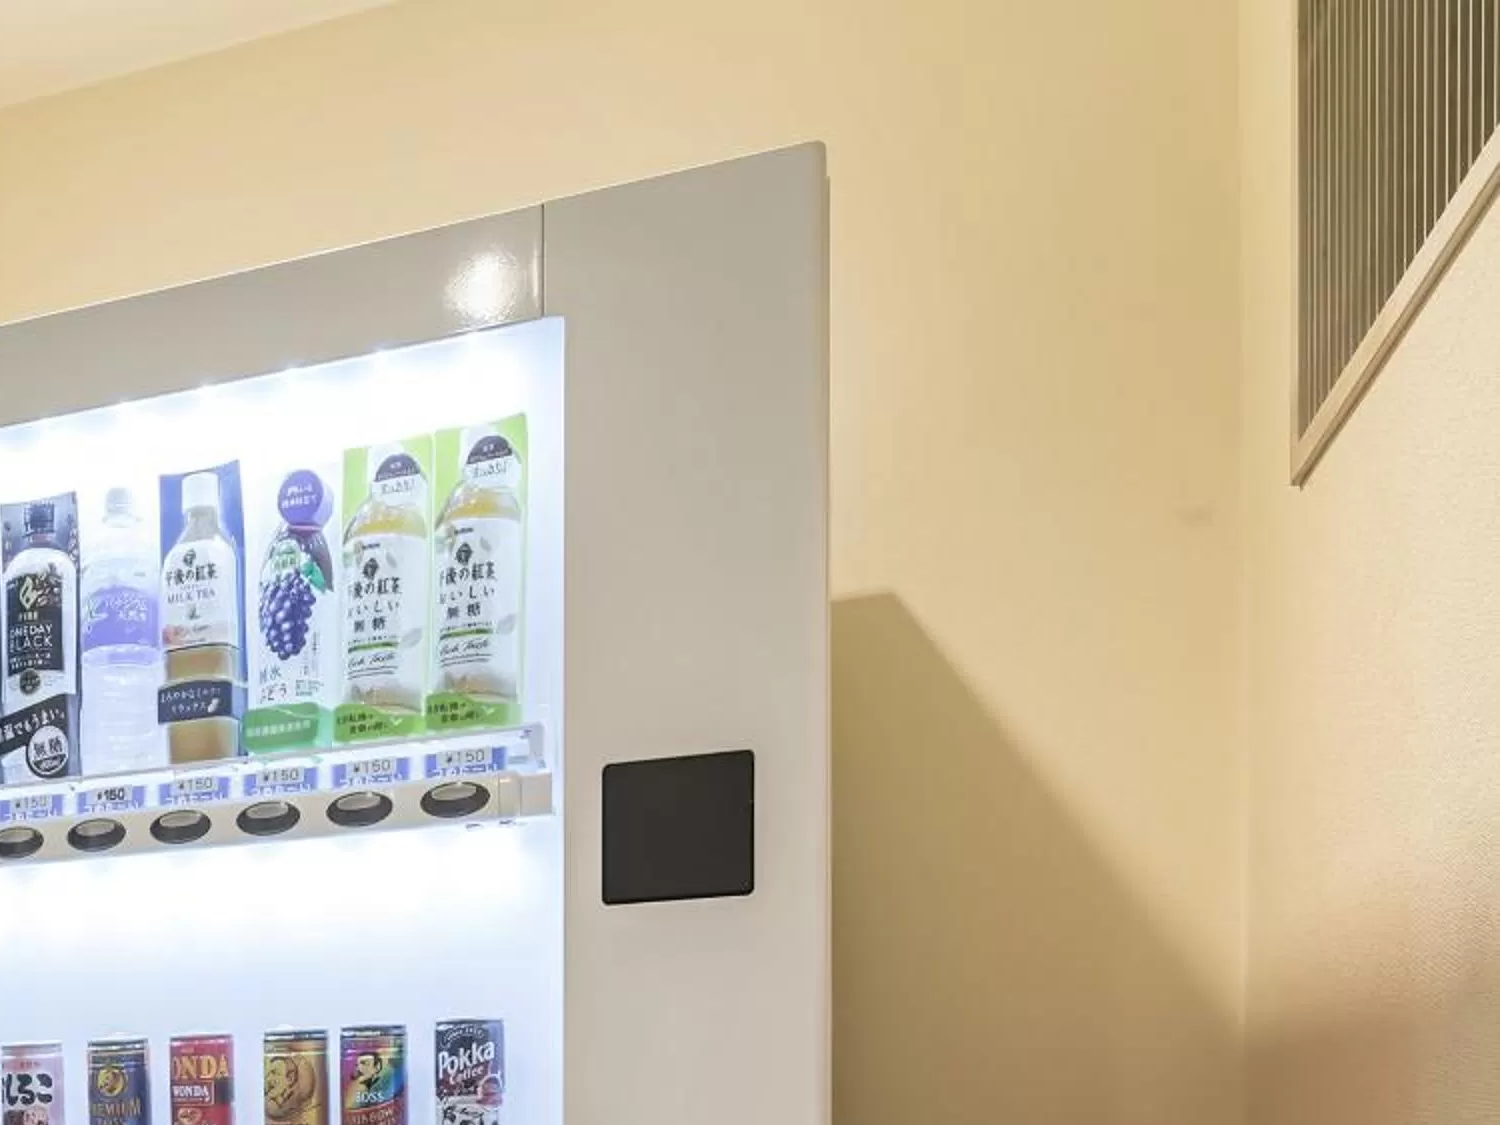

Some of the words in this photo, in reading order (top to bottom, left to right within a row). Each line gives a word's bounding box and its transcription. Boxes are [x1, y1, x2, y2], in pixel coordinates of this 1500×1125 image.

[438, 1041, 495, 1080] Pokka
[1, 1072, 54, 1106] しるこ
